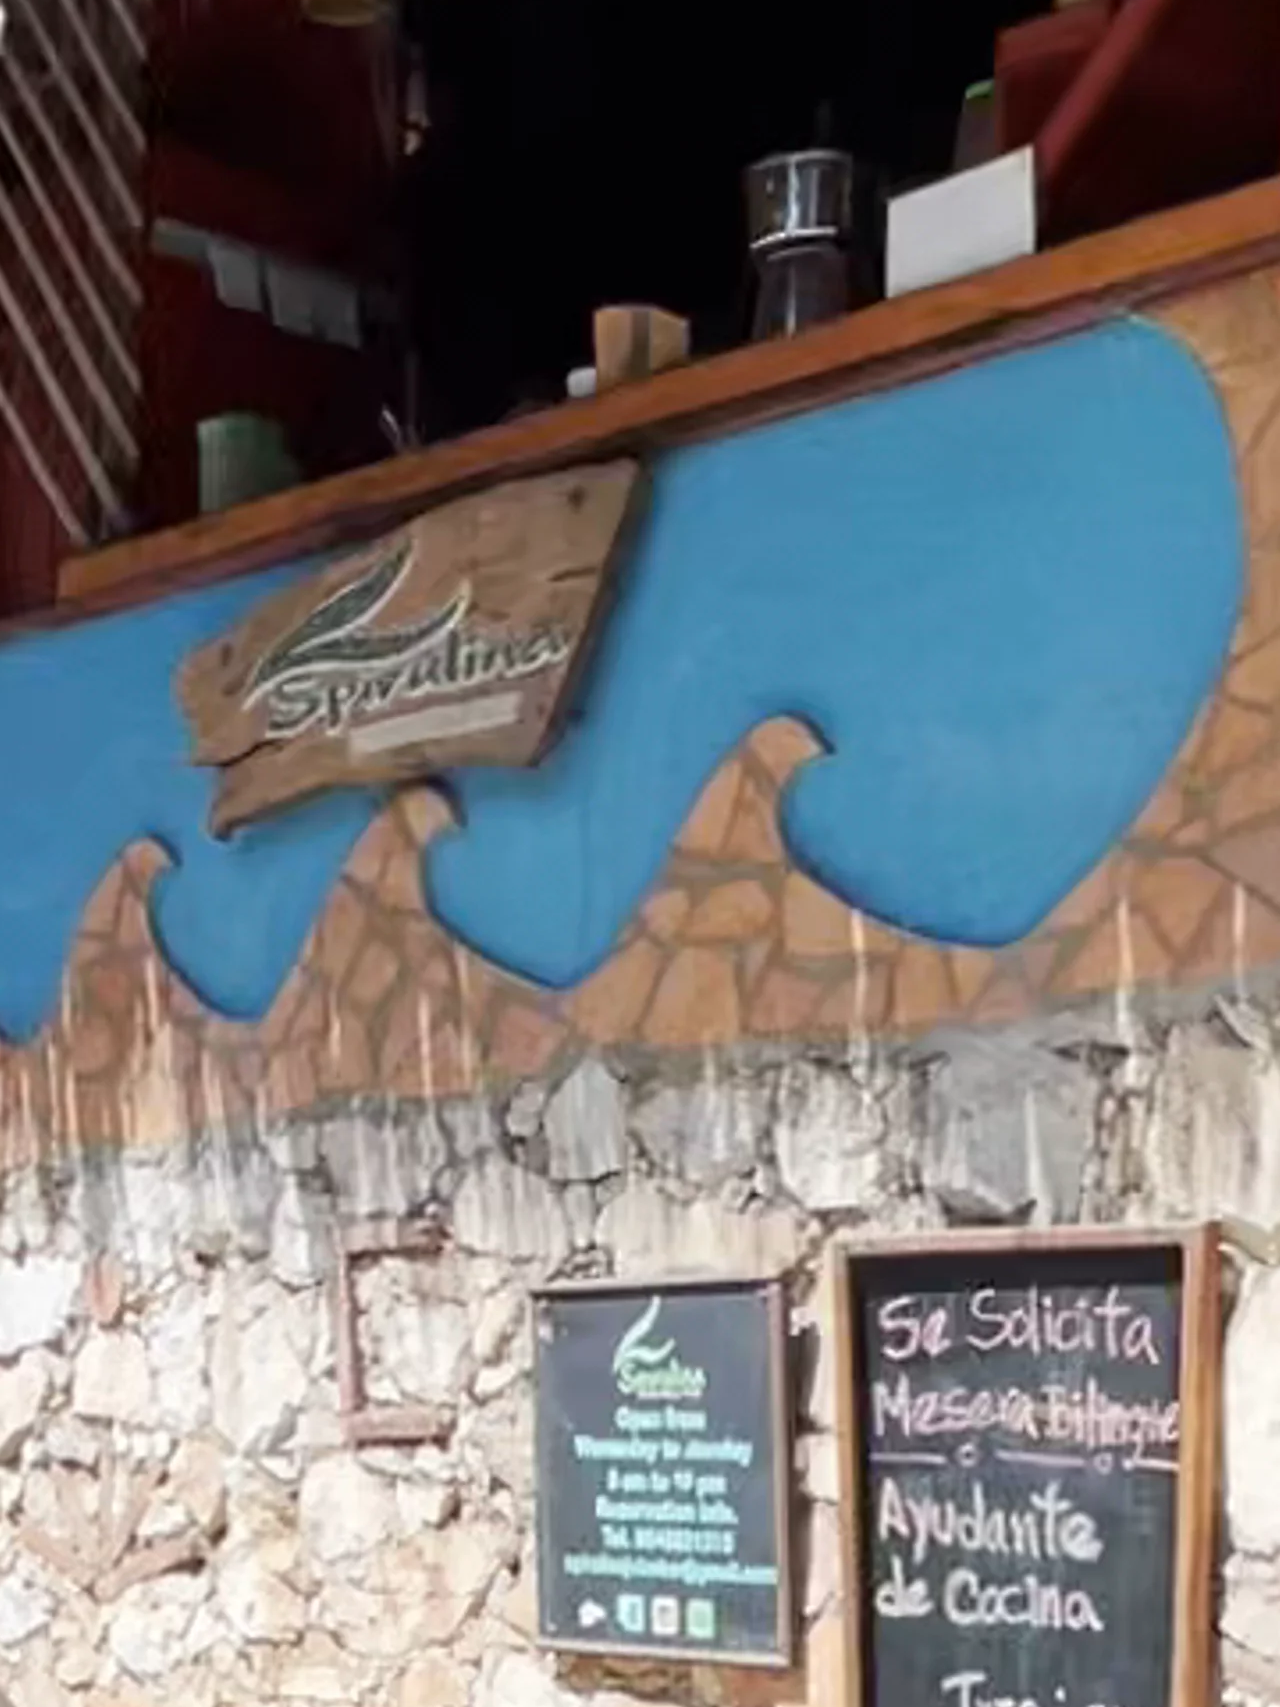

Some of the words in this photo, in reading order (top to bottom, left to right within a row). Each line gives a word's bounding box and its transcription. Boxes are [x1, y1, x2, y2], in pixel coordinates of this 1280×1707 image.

[265, 626, 576, 739] Spirulina
[877, 1294, 952, 1361] Se
[966, 1286, 1160, 1366] Solicita
[878, 1477, 1105, 1564] Ayudante
[875, 1554, 933, 1618] de
[943, 1567, 1106, 1632] Cocina
